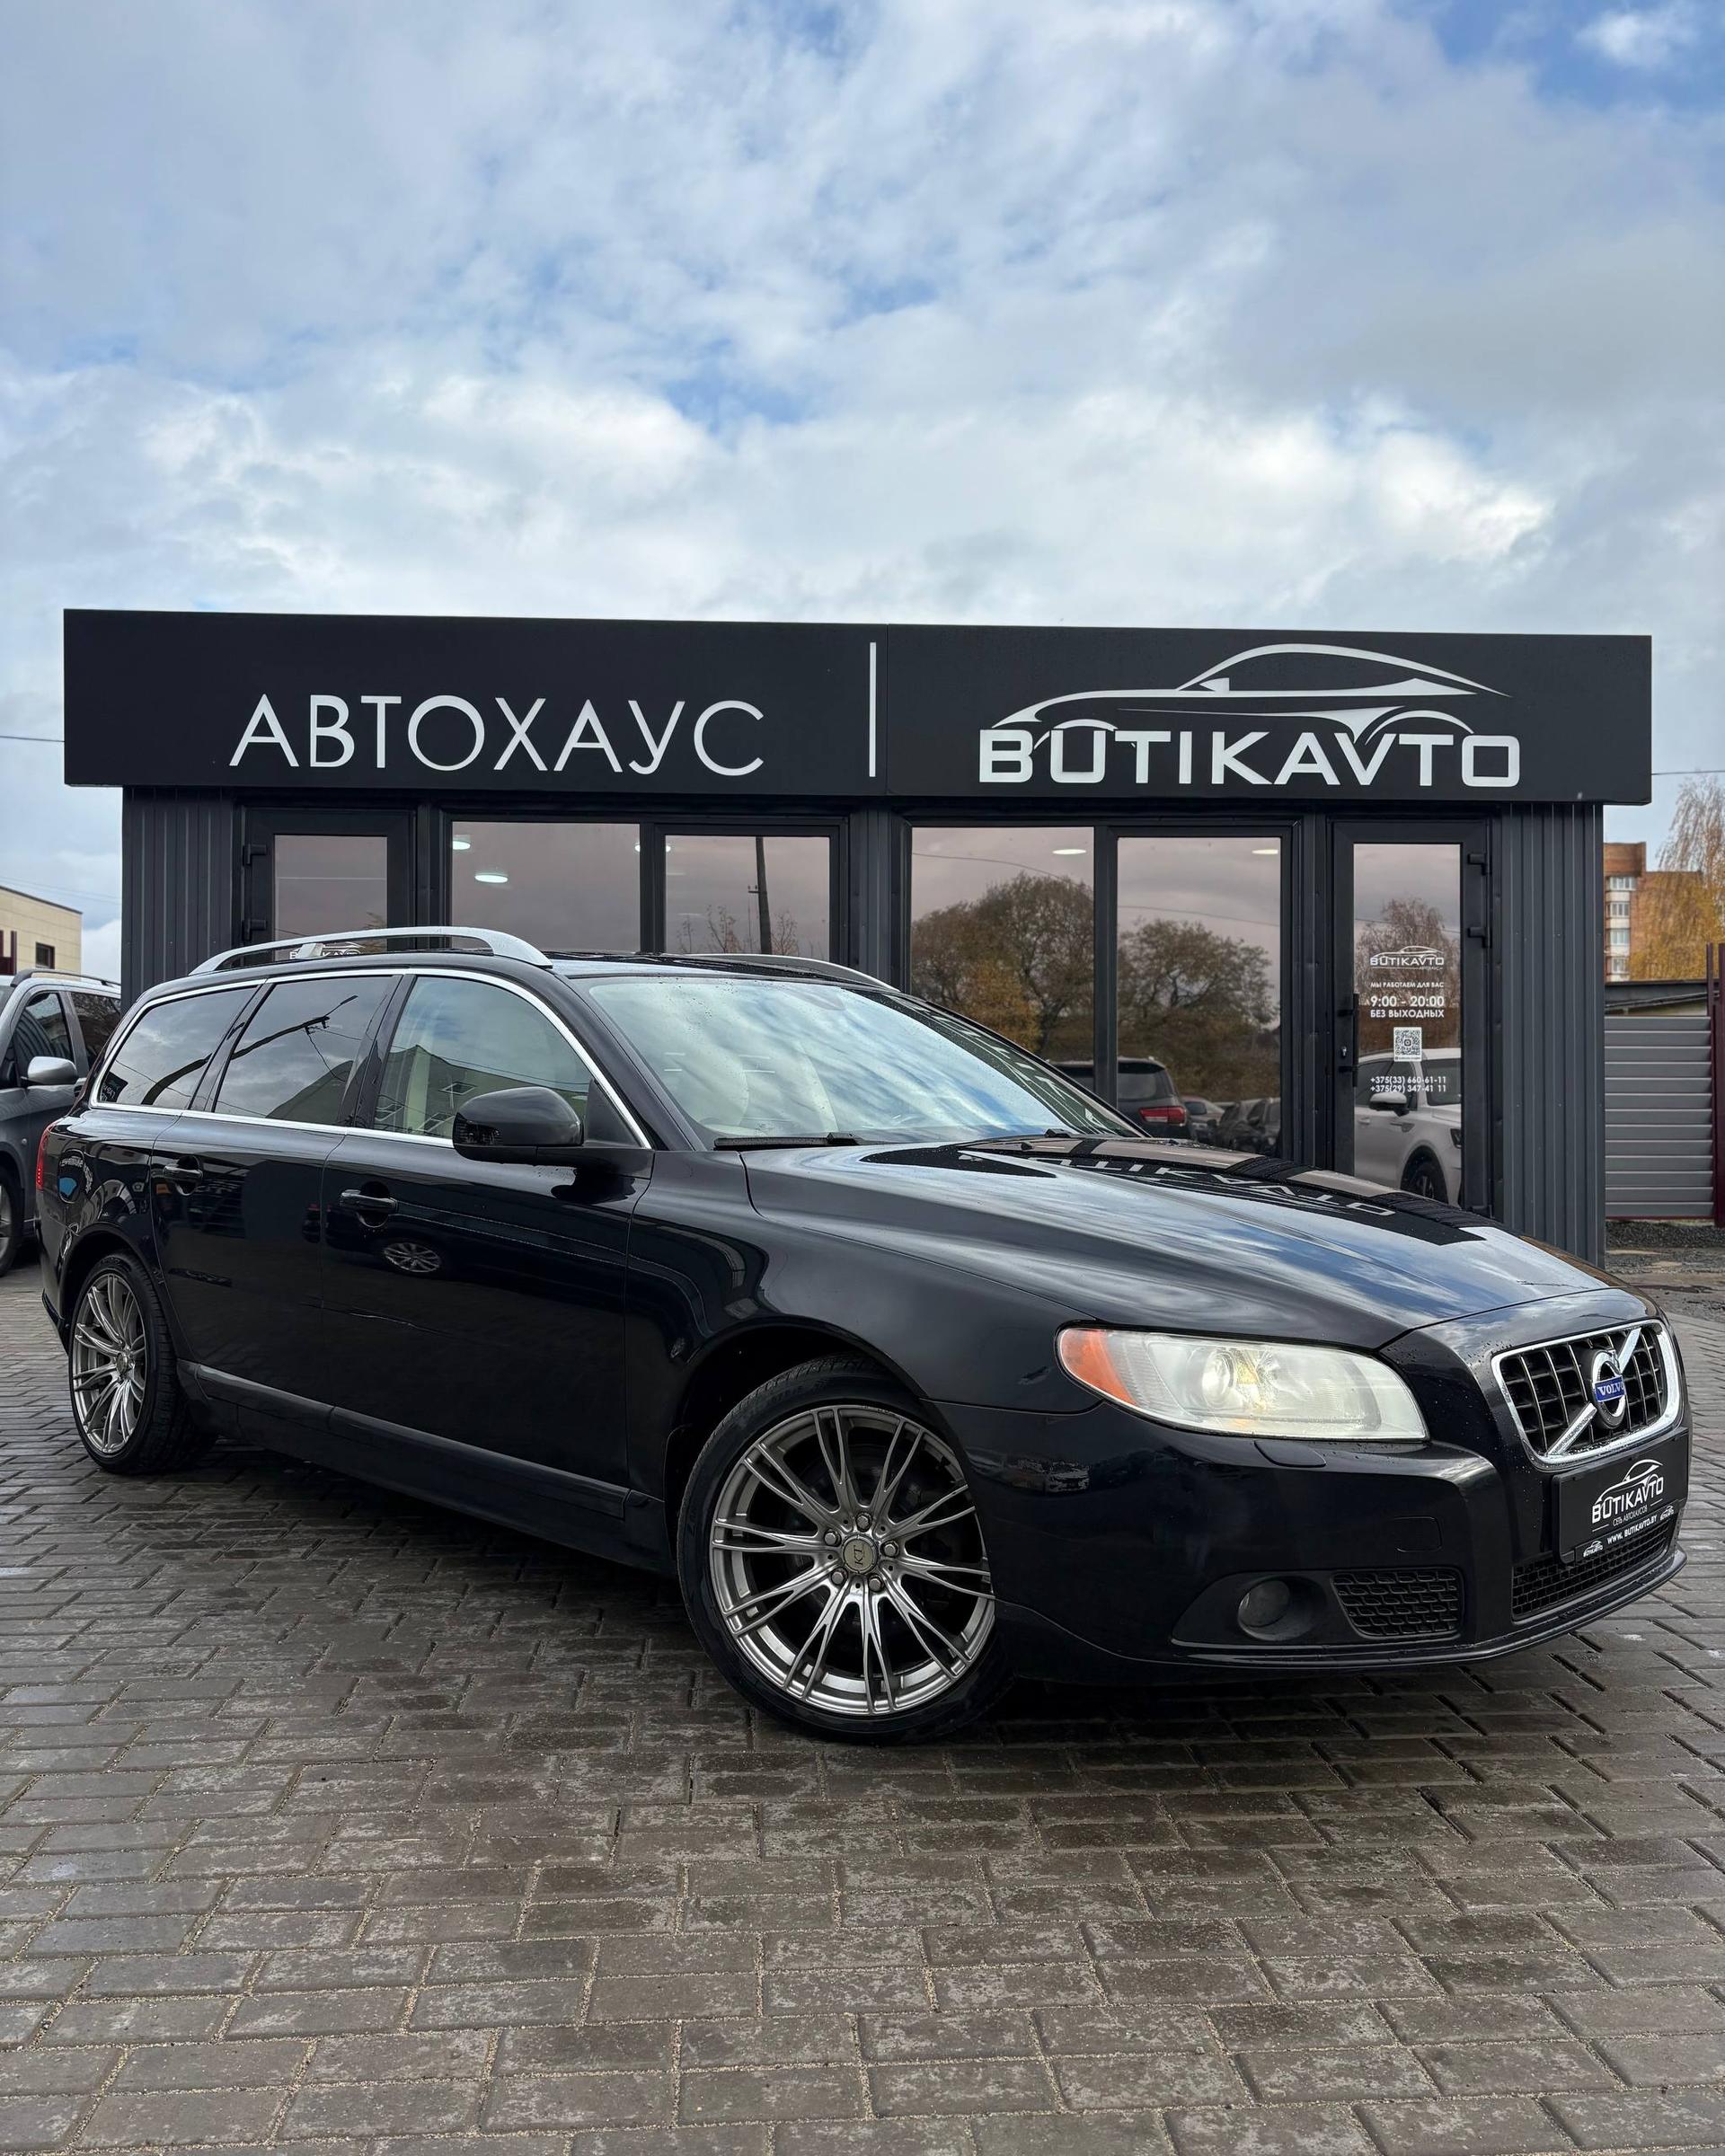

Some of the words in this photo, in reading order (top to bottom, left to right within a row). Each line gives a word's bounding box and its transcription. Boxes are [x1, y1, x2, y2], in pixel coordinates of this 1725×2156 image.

[229, 694, 765, 775] АВТОХАУС
[979, 727, 1520, 788] BUTIKAVTO
[1370, 957, 1444, 966] BUTIKAVTO
[1371, 995, 1397, 1007] 9:00
[1411, 995, 1445, 1007] 20:00
[1370, 1009, 1385, 1018] БЕЗ
[1389, 1009, 1444, 1019] ВЫХОДНЫХ
[1370, 1076, 1405, 1085] +375(33)
[1407, 1076, 1446, 1084] 660-61-11
[1592, 1477, 1664, 1524] BUTIKAVTO
